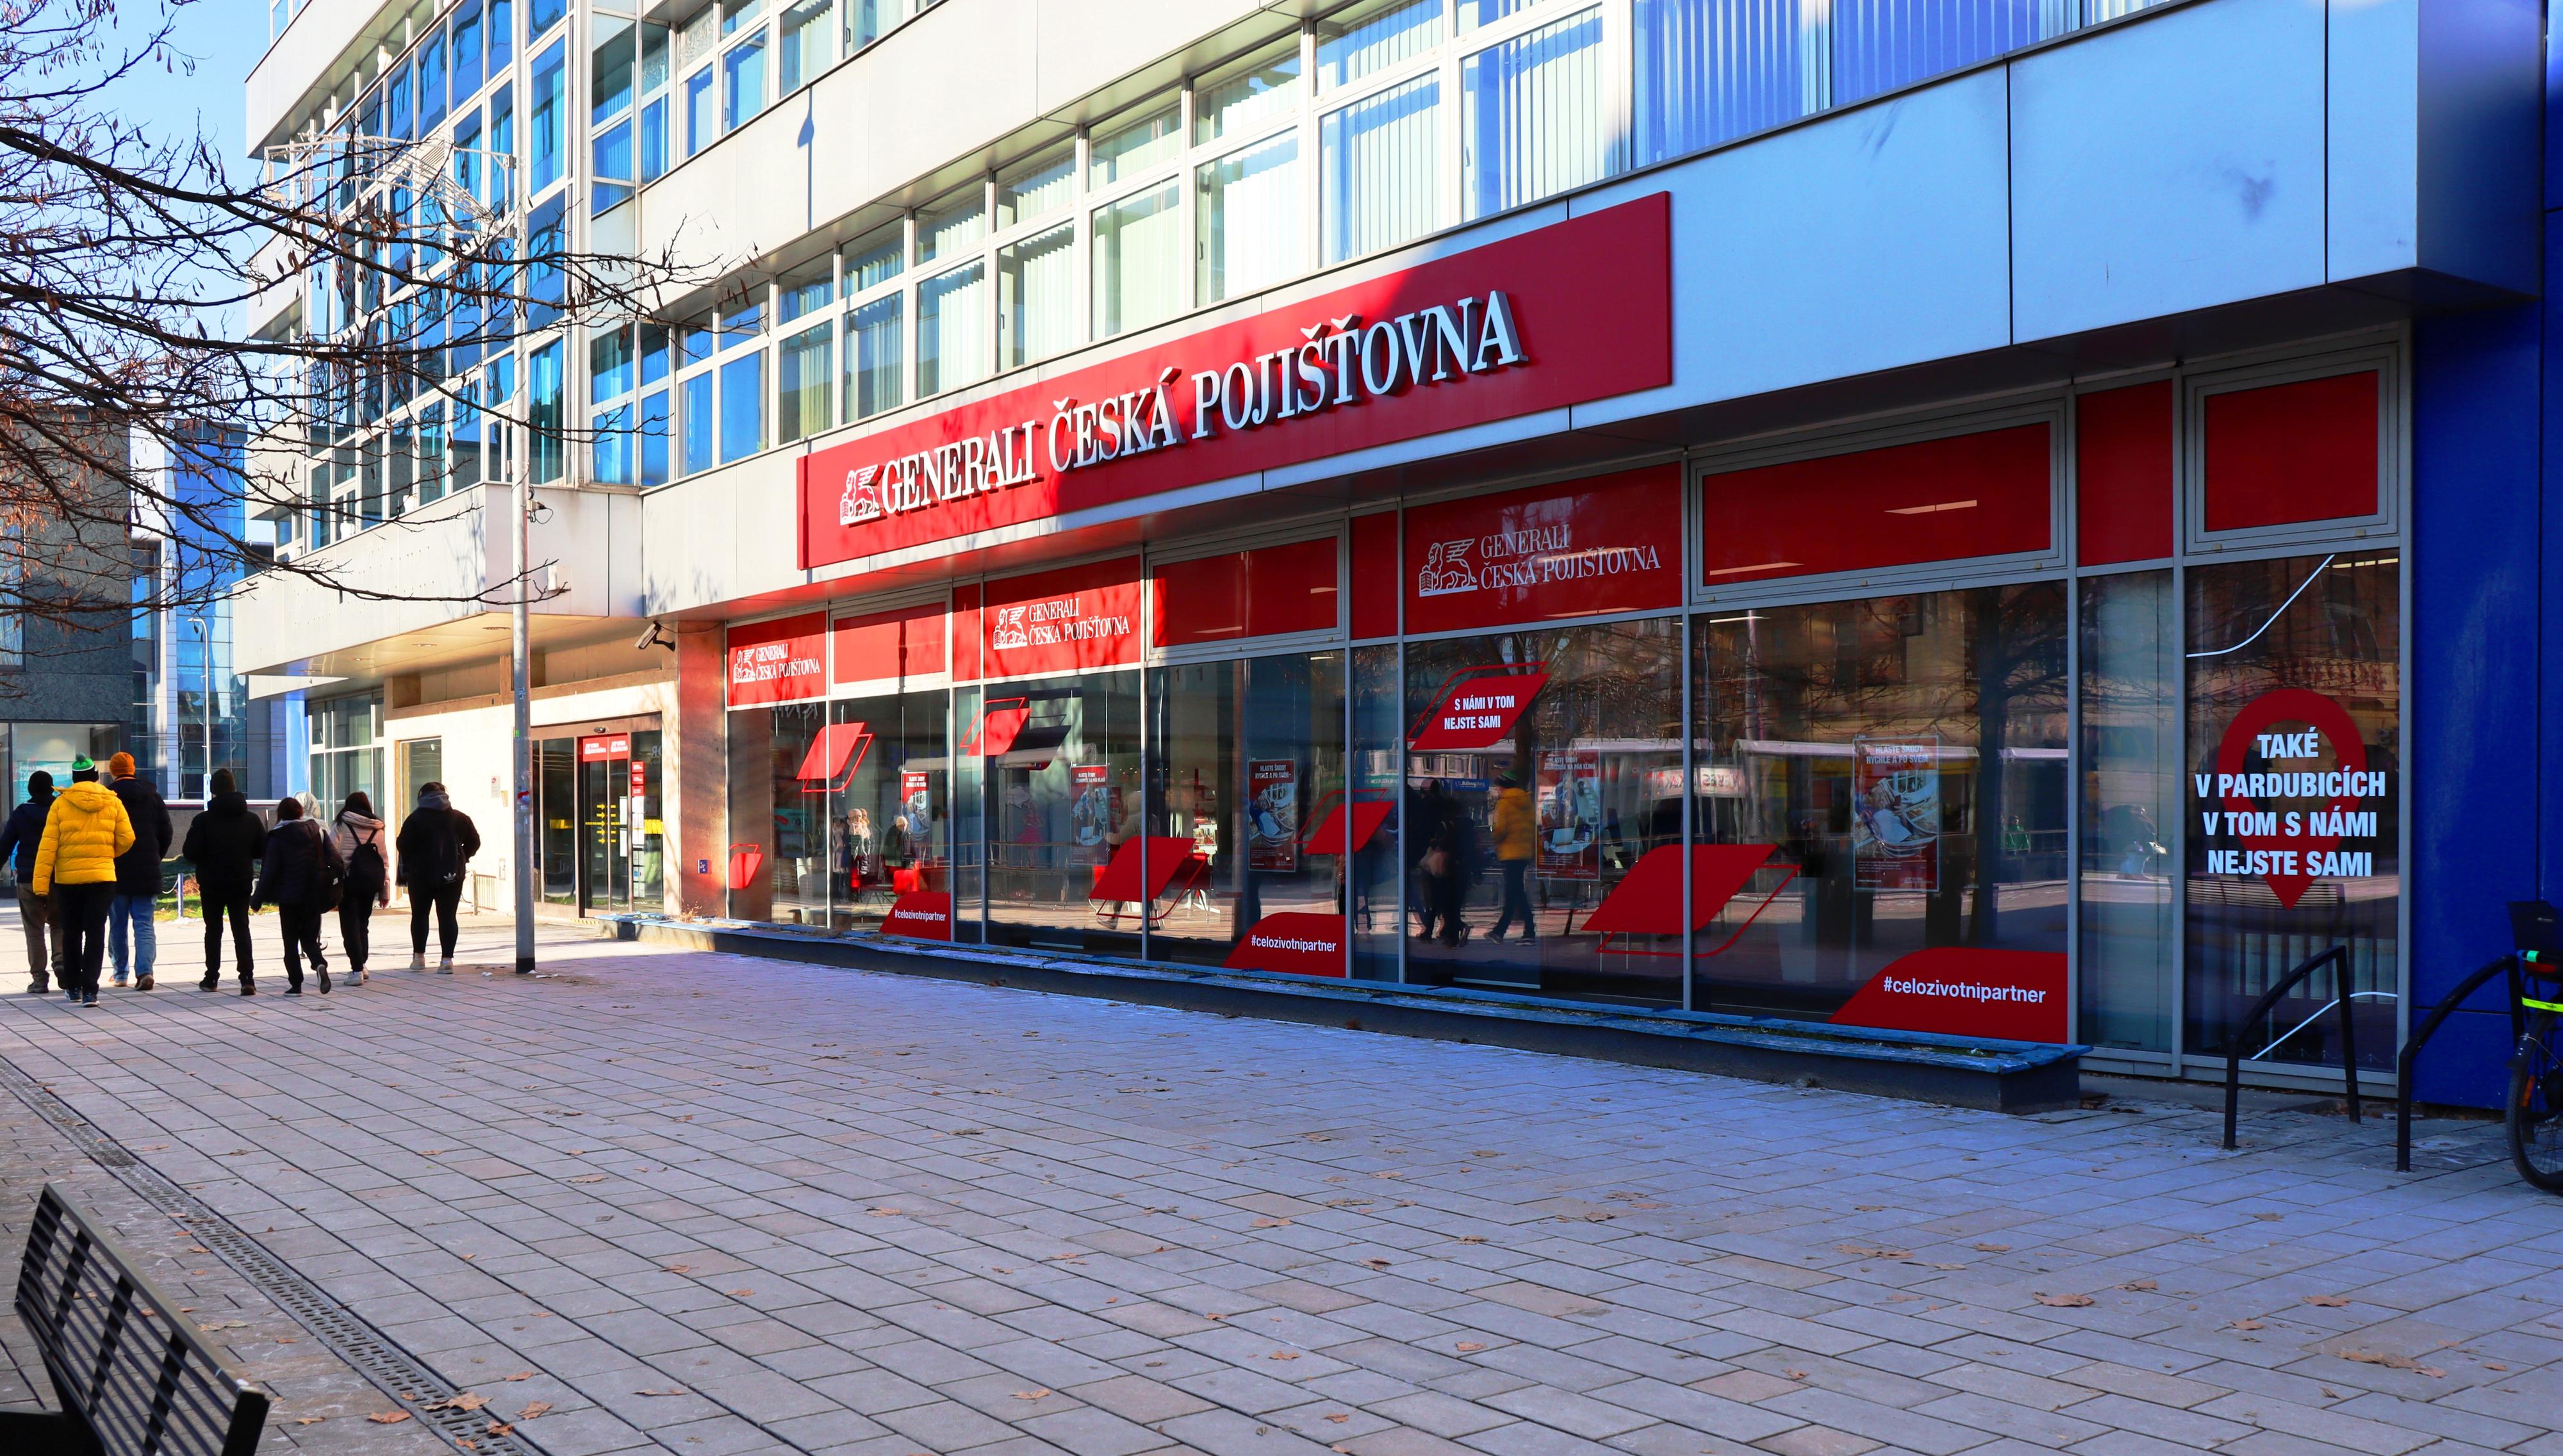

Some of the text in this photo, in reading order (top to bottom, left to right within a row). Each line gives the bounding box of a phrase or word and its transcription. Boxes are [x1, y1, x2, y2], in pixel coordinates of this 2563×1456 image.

[882, 290, 1526, 514] GENERALI ČESKÁ POJIŠŤOVNA
[1480, 525, 1569, 559] GENERALI
[1481, 544, 1661, 589] ČESKÁ POJIŠŤOVNA
[1028, 598, 1080, 623] GENERALI
[1028, 616, 1130, 646] ČESKÁ POJIŠŤOVNA
[756, 644, 788, 661] GENERALI
[756, 658, 820, 680] ČESKÁ POJIŠŤOVNA
[1455, 694, 1515, 711] S NÁMI V TOM
[1444, 715, 1501, 730] NEJSTE SAMI
[2257, 726, 2319, 758] TAKÉ
[2195, 765, 2386, 798] V PARDUBICÍCH
[2202, 805, 2377, 837] V TOM S NÁMI
[2208, 850, 2372, 877] NEJSTE SAMI
[894, 909, 946, 922] #celozivotnipartner
[1251, 935, 1336, 953] #celozivotnipartner
[1883, 976, 2046, 1003] #celozivotnipartner
